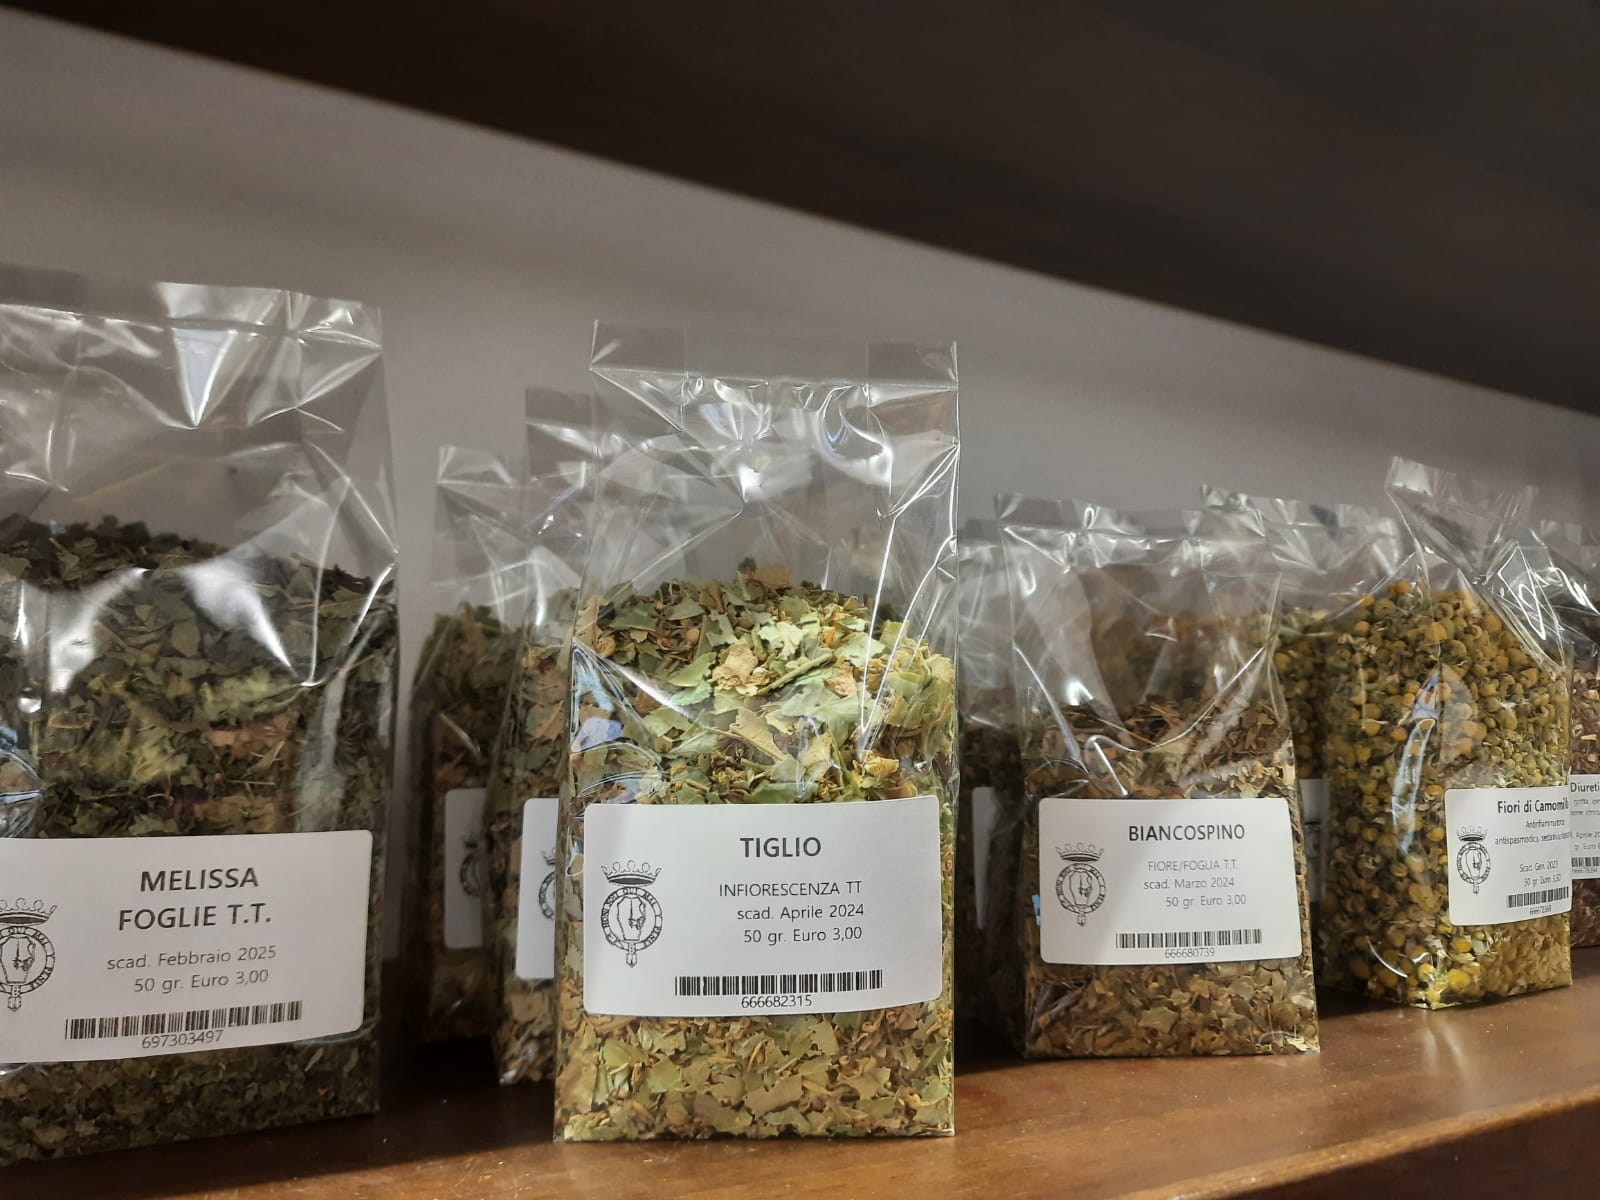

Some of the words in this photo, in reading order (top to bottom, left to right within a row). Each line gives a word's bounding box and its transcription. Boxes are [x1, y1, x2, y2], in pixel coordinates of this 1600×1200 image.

[1497, 799, 1521, 814] Fiori
[1523, 799, 1532, 813] di
[1129, 824, 1245, 841] BIANCOSPINO
[739, 837, 822, 858] TIGLIO
[1148, 860, 1220, 872] FIORE/FOGLIA
[140, 867, 259, 892] MELISSA
[1144, 879, 1170, 889] scad.
[1174, 879, 1207, 888] Marzo
[1211, 877, 1234, 887] 2024
[720, 881, 840, 896] INFIORESCENZA
[845, 881, 862, 894] TT
[1166, 897, 1179, 907] 50
[1201, 896, 1223, 905] Euro
[1227, 894, 1246, 904] 3,00
[119, 906, 216, 931] FOGLIE
[227, 903, 271, 925] T.T.
[737, 906, 774, 920] scad.
[780, 905, 823, 921] Aprile
[829, 904, 865, 918] 2024
[744, 930, 762, 943] 50
[768, 933, 787, 946] gr.
[793, 929, 829, 942] Euro
[832, 926, 863, 942] 3,00
[107, 953, 150, 970] scad.
[158, 949, 231, 966] Febbraio
[237, 946, 276, 961] 2025
[1164, 947, 1216, 959] 666680739
[134, 978, 155, 992] 50
[162, 977, 184, 994] gr.
[191, 975, 229, 988] Euro
[236, 969, 268, 986] 3,00
[741, 994, 813, 1008] 666682315
[141, 1030, 224, 1049] 697303497
